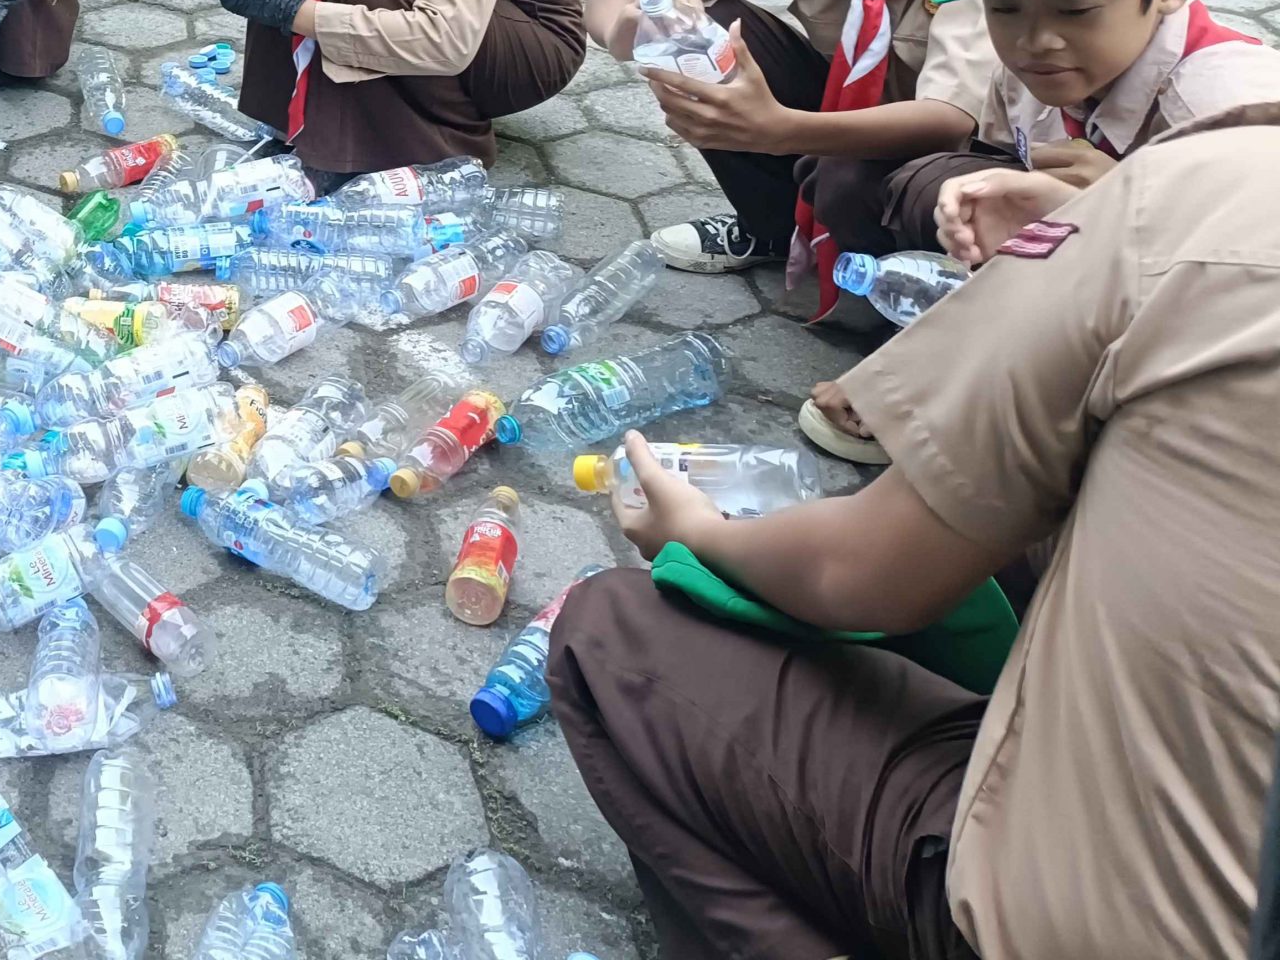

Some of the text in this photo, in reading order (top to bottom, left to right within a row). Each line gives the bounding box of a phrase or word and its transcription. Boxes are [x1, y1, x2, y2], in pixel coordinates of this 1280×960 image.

[28, 562, 40, 575] Le
[18, 879, 51, 922] Minerale
[19, 899, 32, 914] Le
